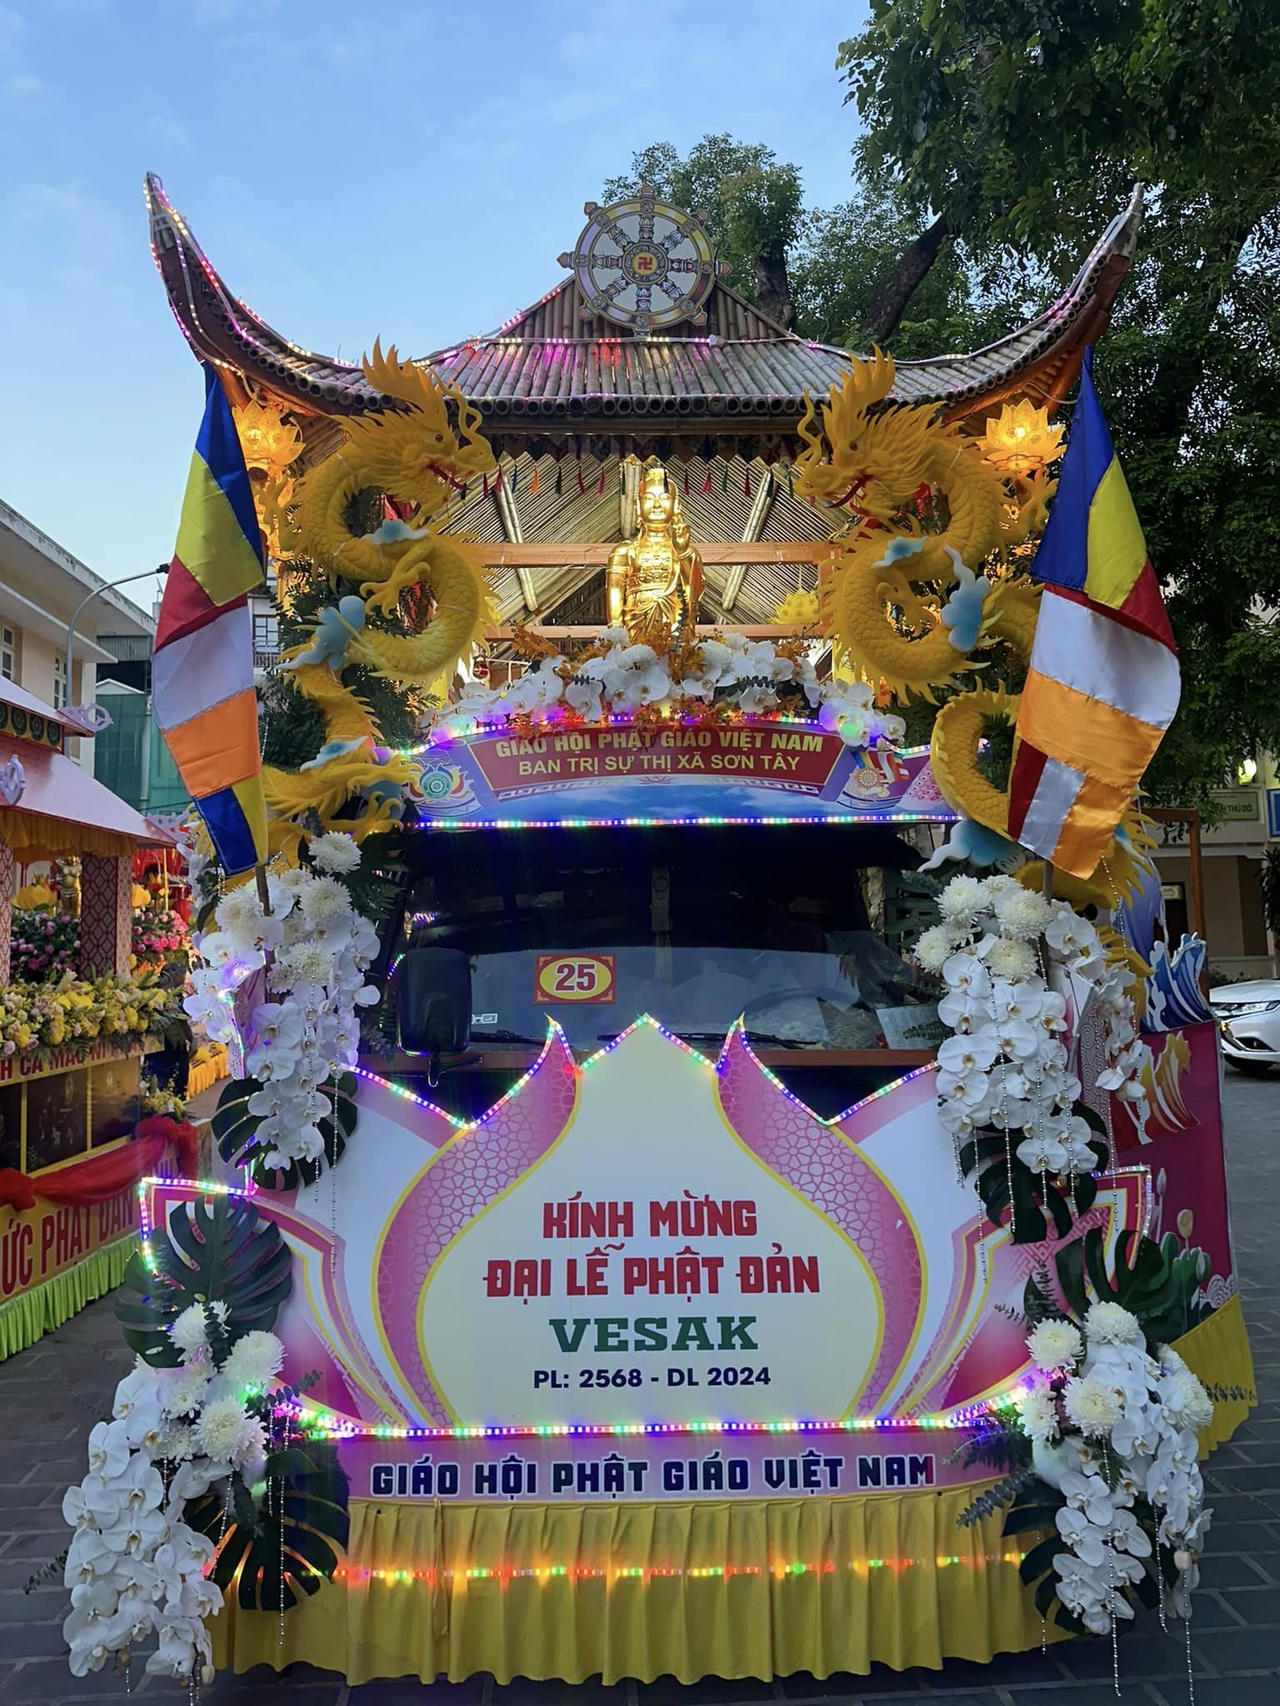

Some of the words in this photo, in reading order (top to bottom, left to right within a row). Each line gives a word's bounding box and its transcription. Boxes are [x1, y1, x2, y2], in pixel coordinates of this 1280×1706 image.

[496, 736, 547, 758] GIÁO
[554, 732, 591, 754] HỘI
[599, 730, 654, 751] PHẬT
[661, 728, 712, 748] GIÁO
[719, 728, 765, 751] VIỆT
[771, 733, 823, 753] NAM
[519, 759, 561, 775] BAN
[567, 757, 598, 775] TRỊ
[604, 755, 635, 774] SỰ
[640, 754, 672, 773] THỊ
[677, 751, 705, 769] XÃ
[711, 754, 754, 770] SƠN
[760, 751, 801, 770] TÂY
[555, 963, 597, 992] 25
[543, 1191, 634, 1239] KÍNH
[649, 1190, 758, 1237] MỪNG
[482, 1259, 552, 1305] ĐẠI
[566, 1243, 625, 1296] LỄ
[623, 1245, 725, 1302] PHẬT
[735, 1242, 821, 1294] ĐẢN
[549, 1316, 759, 1352] VESAK
[533, 1370, 570, 1388] PL:
[579, 1369, 643, 1388] 2568
[667, 1368, 699, 1387] DL
[707, 1367, 772, 1386] 2024
[371, 1455, 459, 1495] GIÁO
[474, 1454, 537, 1500] HỘI
[553, 1452, 649, 1499] PHẬT
[663, 1451, 749, 1491] GIÁO
[764, 1449, 844, 1494] VIỆT
[858, 1454, 934, 1487] NAM
